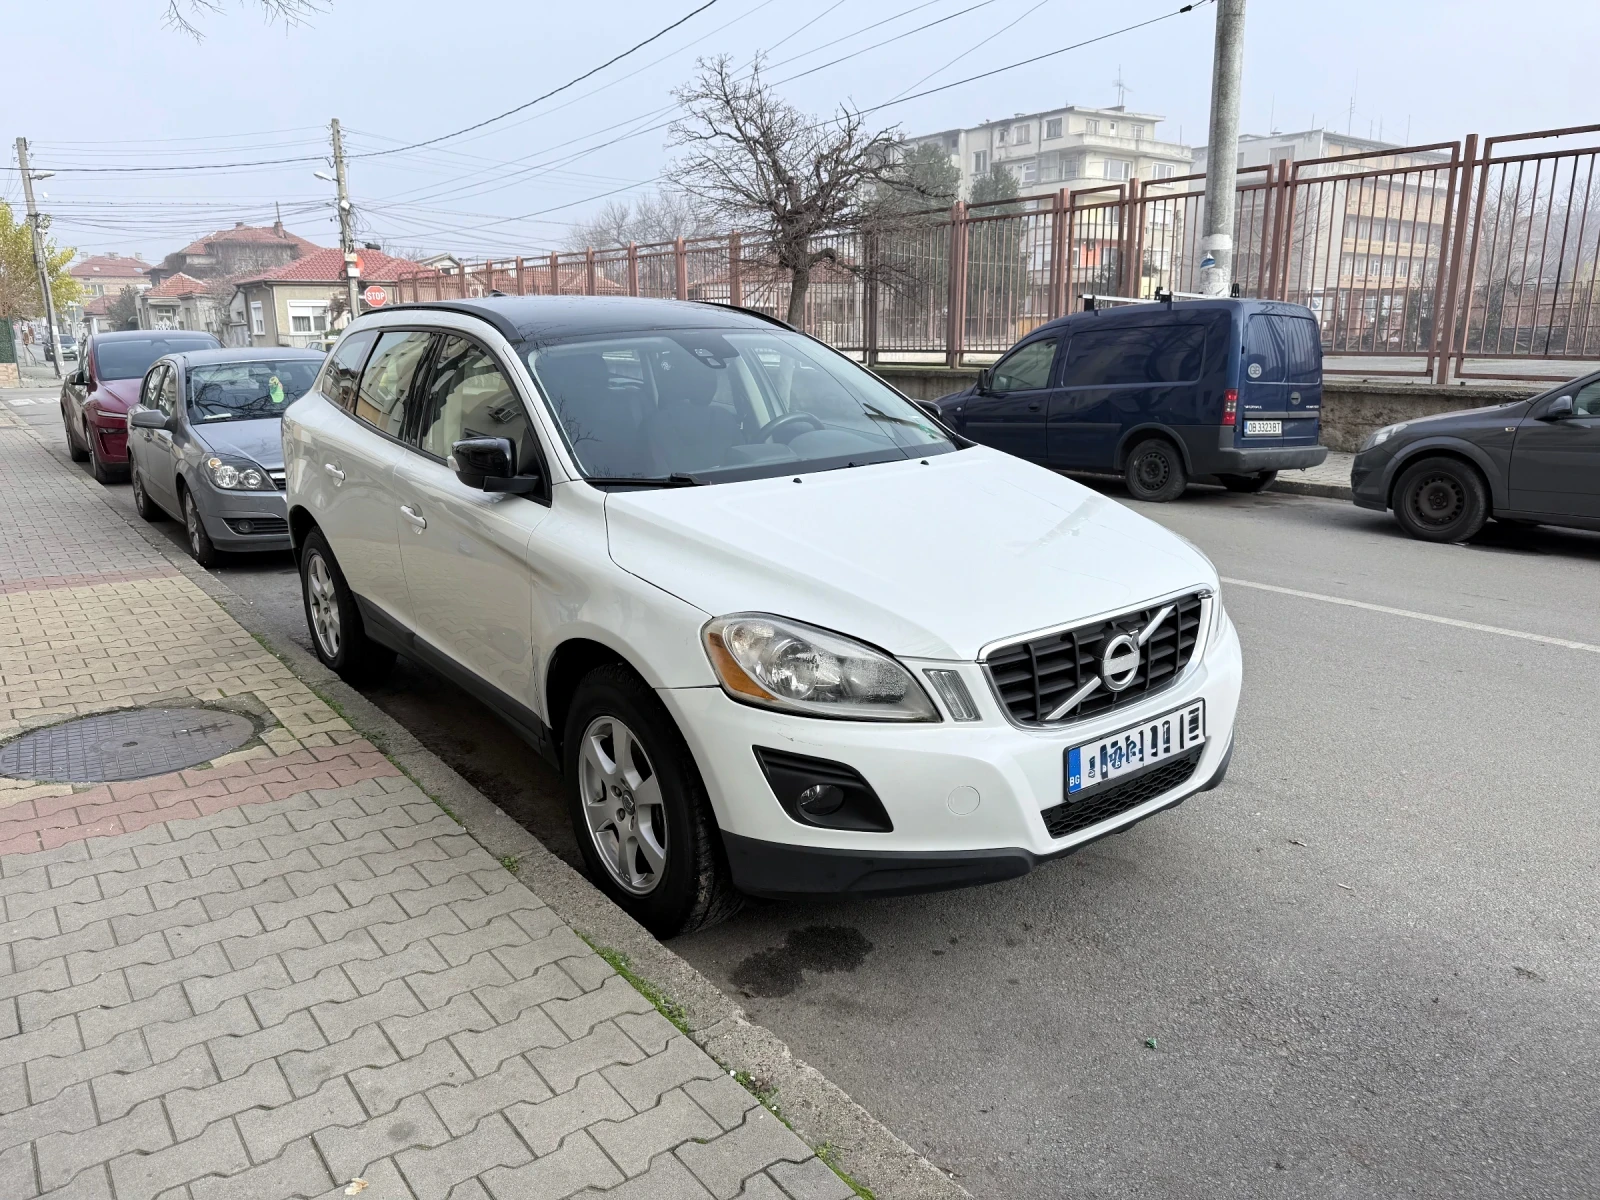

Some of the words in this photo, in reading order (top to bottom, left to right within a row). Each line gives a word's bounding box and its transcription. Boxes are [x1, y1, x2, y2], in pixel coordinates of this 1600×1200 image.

[367, 292, 385, 300] STOP
[1250, 365, 1260, 375] GB
[1258, 422, 1272, 432] 3323
[1273, 422, 1280, 432] BT
[1070, 774, 1080, 786] BG
